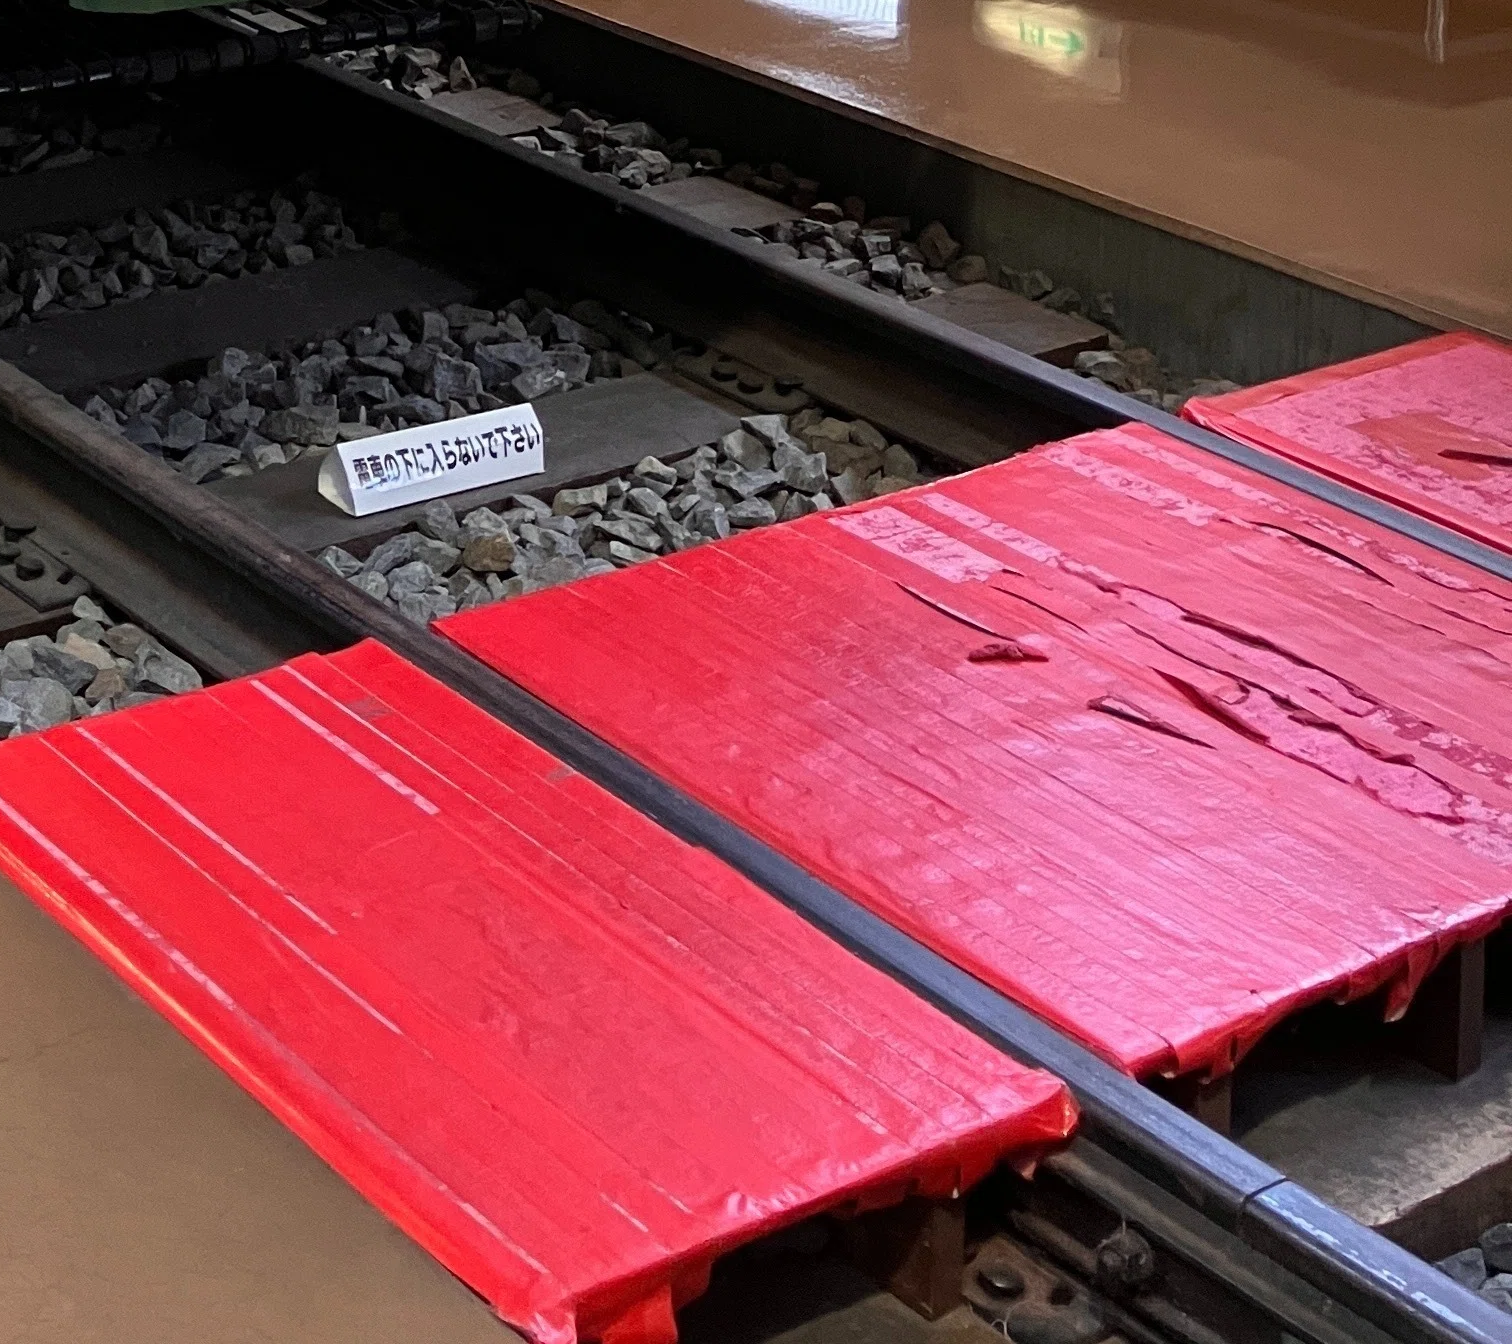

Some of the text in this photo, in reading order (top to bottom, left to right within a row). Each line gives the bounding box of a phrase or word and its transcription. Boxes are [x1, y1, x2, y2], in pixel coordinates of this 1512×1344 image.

[353, 424, 541, 489] 電車の下に入らないで下さい
